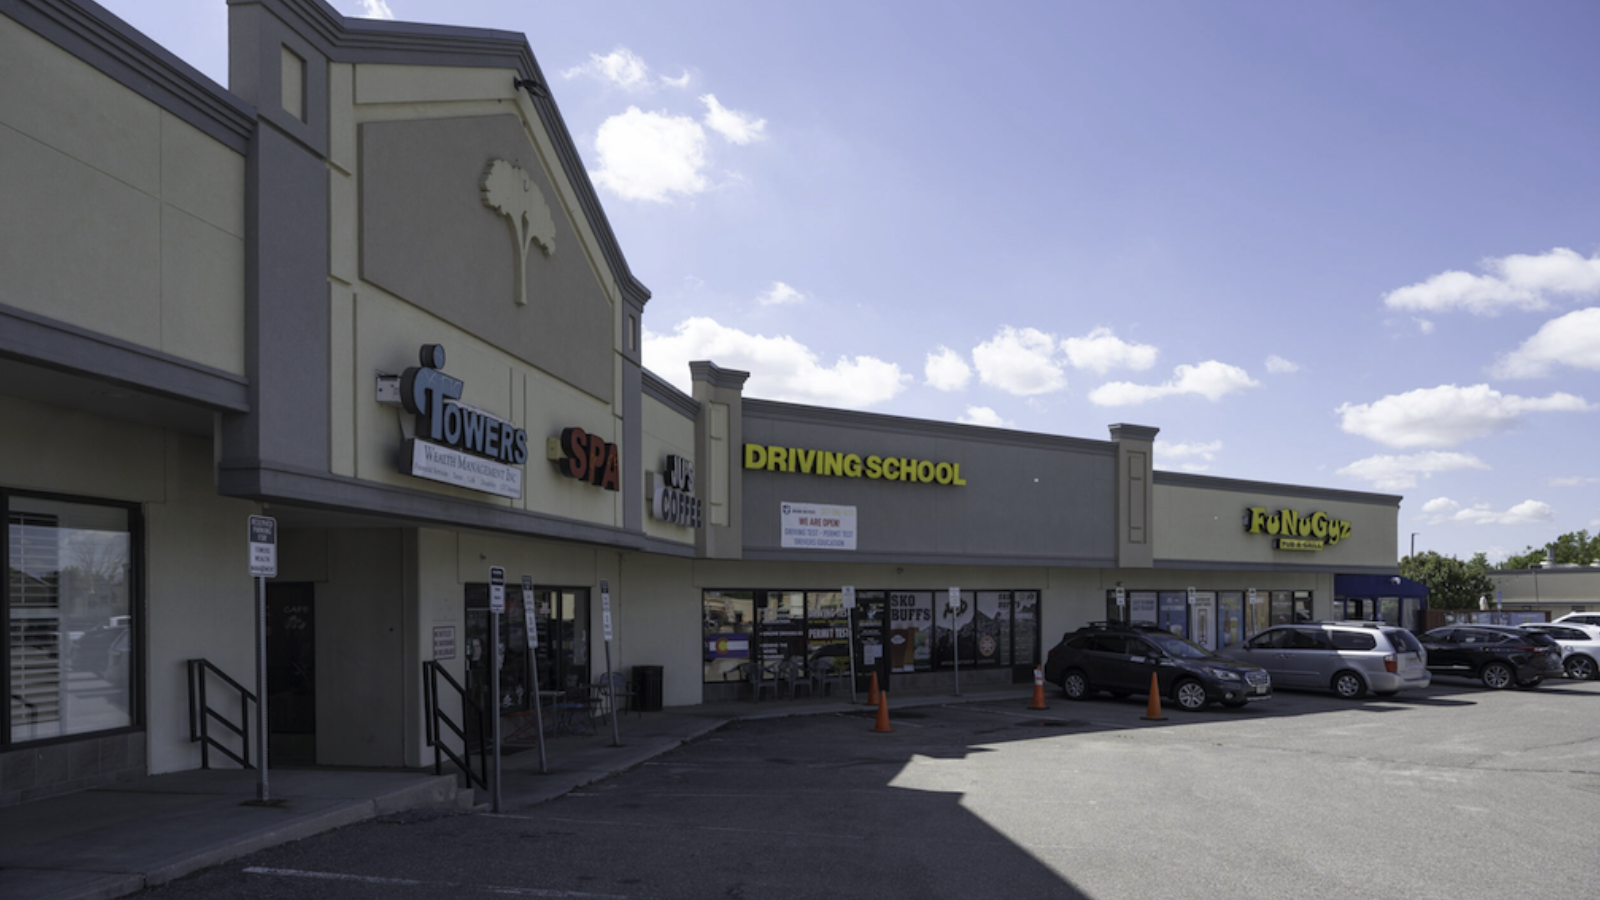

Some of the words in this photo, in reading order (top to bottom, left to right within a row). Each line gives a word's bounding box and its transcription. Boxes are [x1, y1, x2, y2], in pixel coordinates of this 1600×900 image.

[411, 366, 527, 464] TOWERS
[424, 445, 457, 469] WEALTH
[457, 457, 505, 480] MANAGEMENT
[565, 426, 619, 491] SPA
[744, 443, 862, 478] DRIVING
[865, 454, 967, 486] SCHOOL
[662, 488, 702, 528] COFFEE
[798, 517, 808, 526] WE
[810, 517, 821, 527] ARE
[785, 527, 806, 536] DRIVING
[807, 528, 818, 537] TEST
[843, 530, 853, 538] TEST
[817, 538, 845, 547] EDUCATION
[891, 593, 915, 606] SKO
[891, 608, 931, 621] BUFFS
[808, 628, 833, 639] PERMIT
